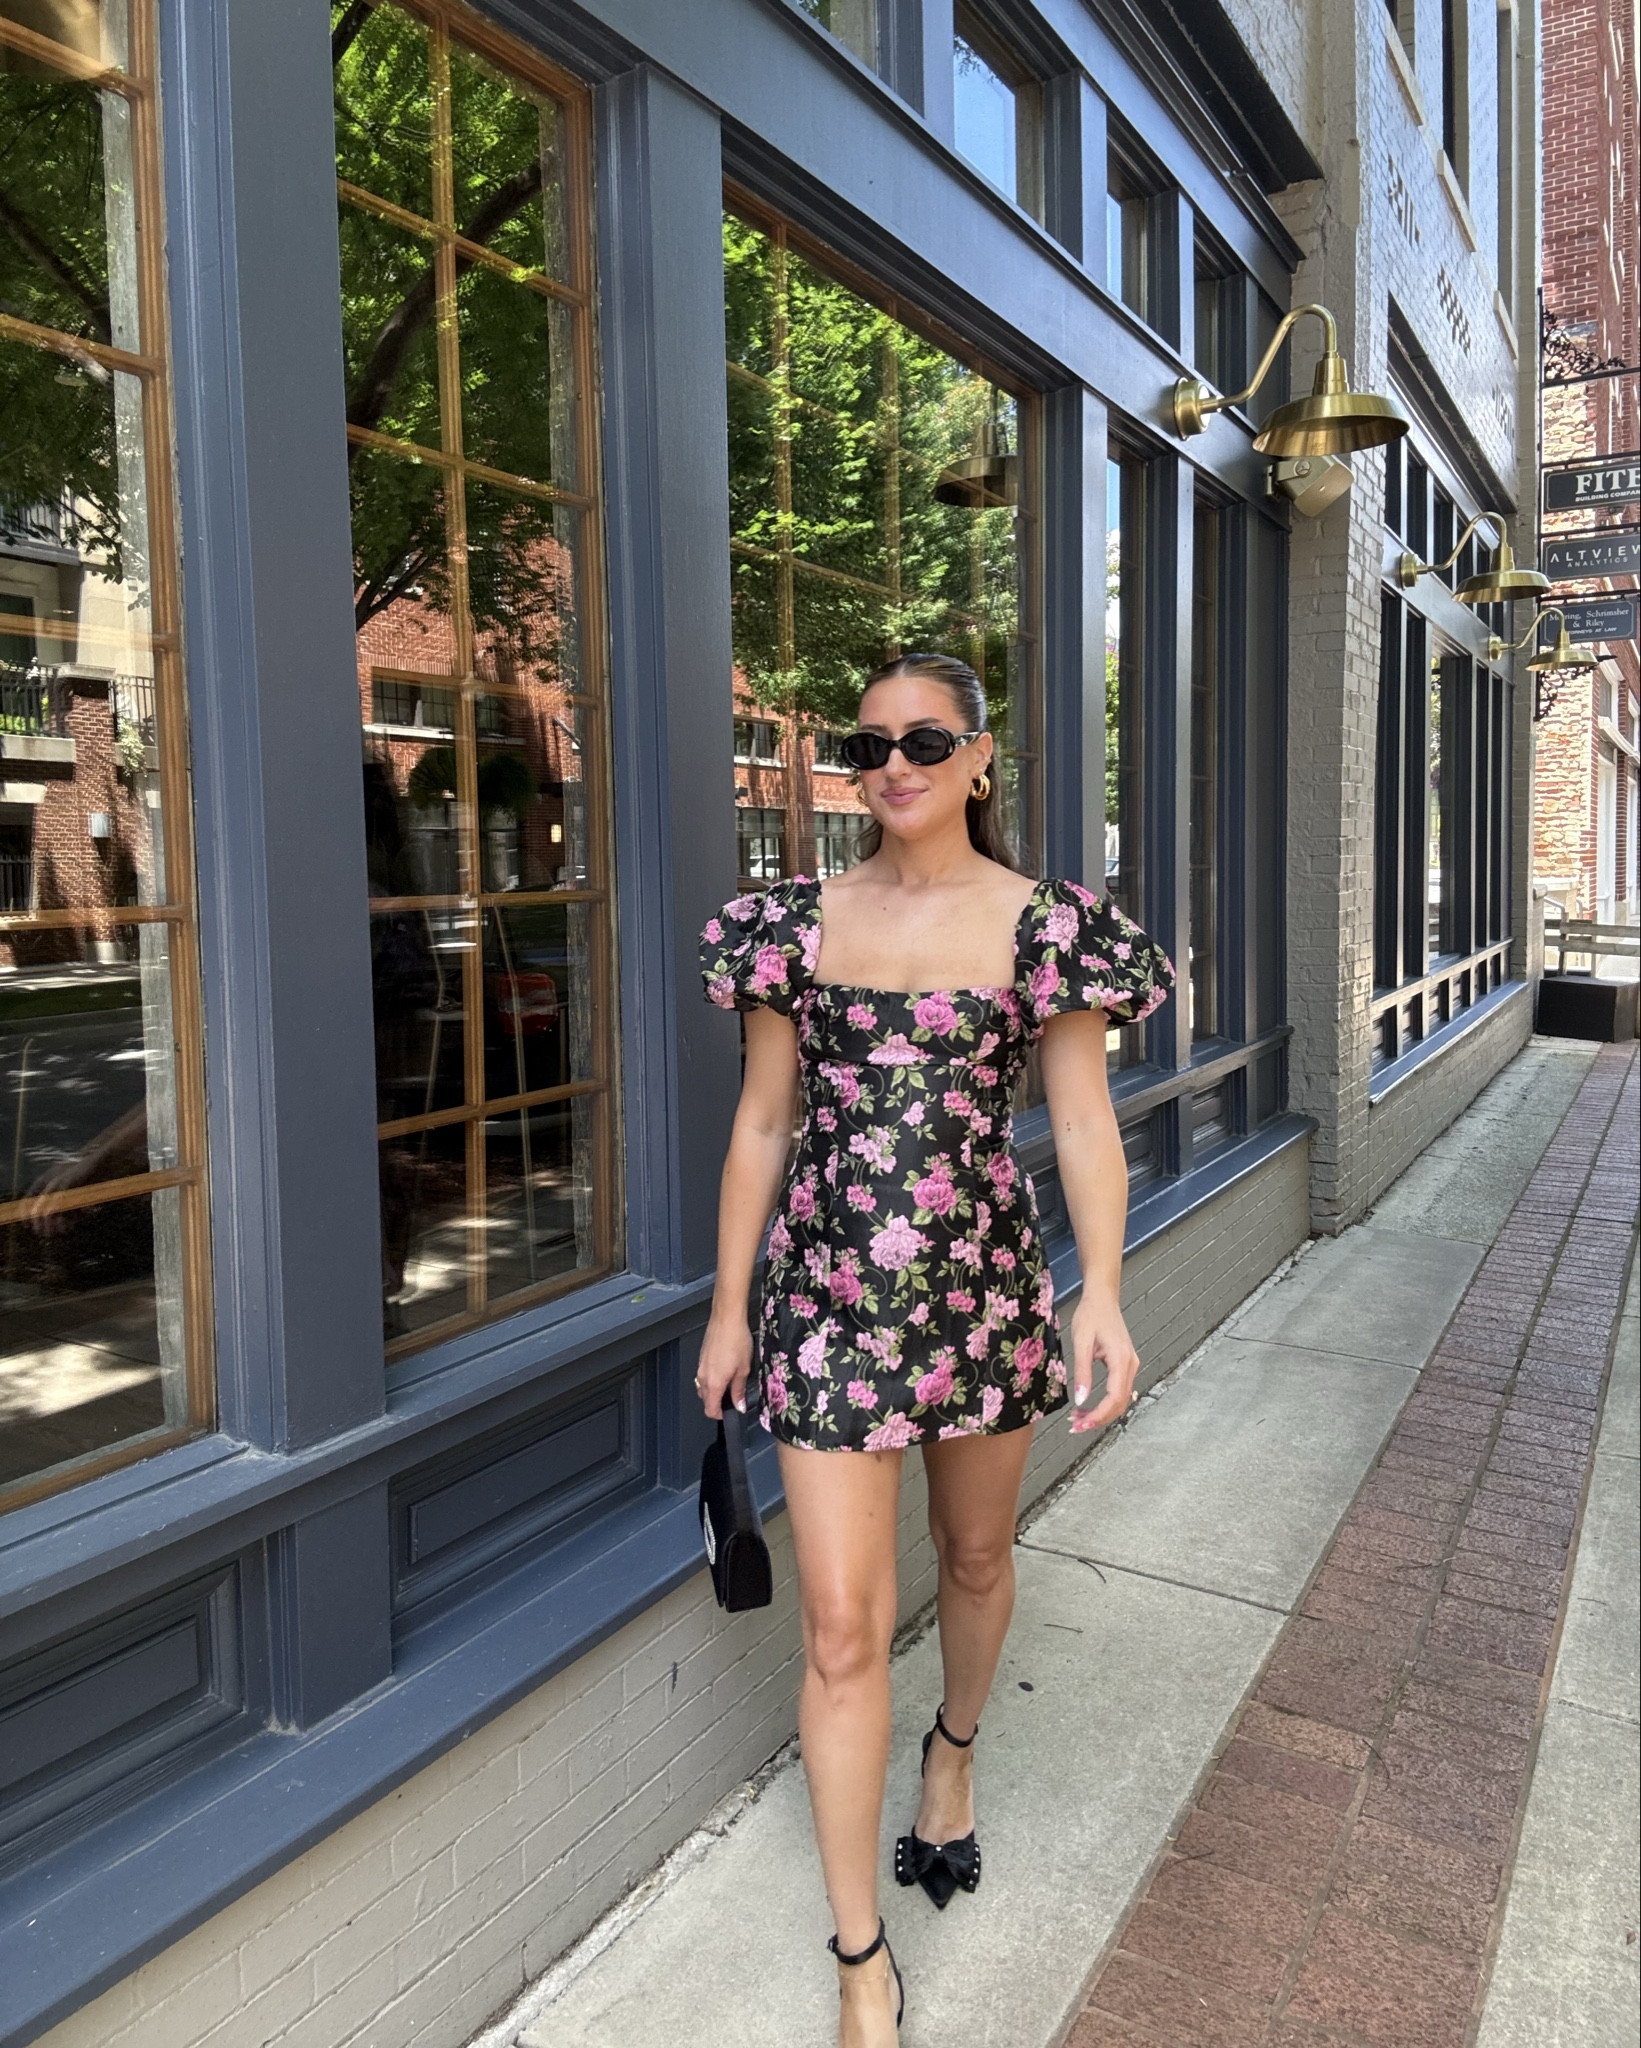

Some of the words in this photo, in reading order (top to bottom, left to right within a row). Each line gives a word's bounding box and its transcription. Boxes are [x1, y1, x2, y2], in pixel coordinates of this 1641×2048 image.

[1575, 493, 1609, 502] BUILDING
[1567, 557, 1628, 568] ANALYTICS
[1586, 608, 1629, 618] Schrimsher
[1572, 620, 1580, 628] &
[1585, 619, 1604, 627] Riley
